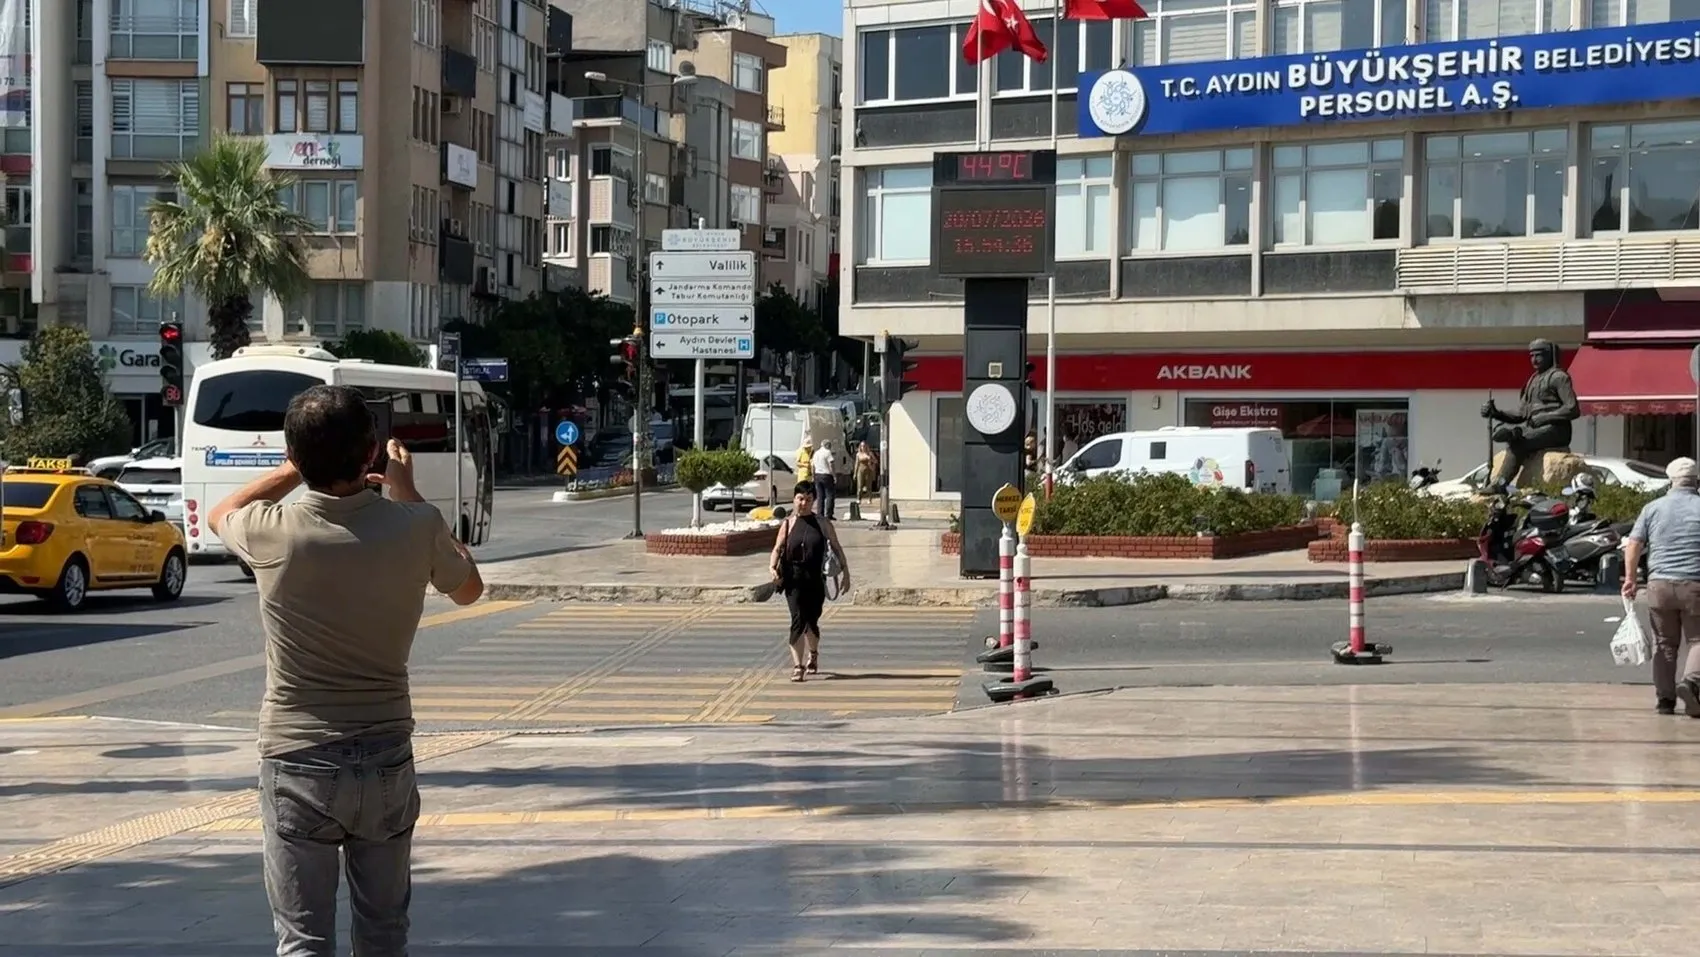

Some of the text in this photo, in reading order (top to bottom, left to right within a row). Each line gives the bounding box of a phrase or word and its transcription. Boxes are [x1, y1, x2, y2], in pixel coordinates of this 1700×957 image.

[1160, 31, 1700, 97] T.C. AYDIN BÜYÜKŞEHİR BELEDİYESİ
[1300, 81, 1519, 117] PERSONEL A.Ş.
[709, 260, 747, 270] Valilik
[668, 283, 752, 291] Jandarma Komando
[697, 292, 749, 301] Komutanlığı
[667, 313, 719, 327] Otopark
[680, 336, 736, 346] Aydın Devlet
[120, 349, 161, 367] Gara
[1156, 365, 1252, 380] AKBANK
[1212, 405, 1278, 419] Gişe Ekstra
